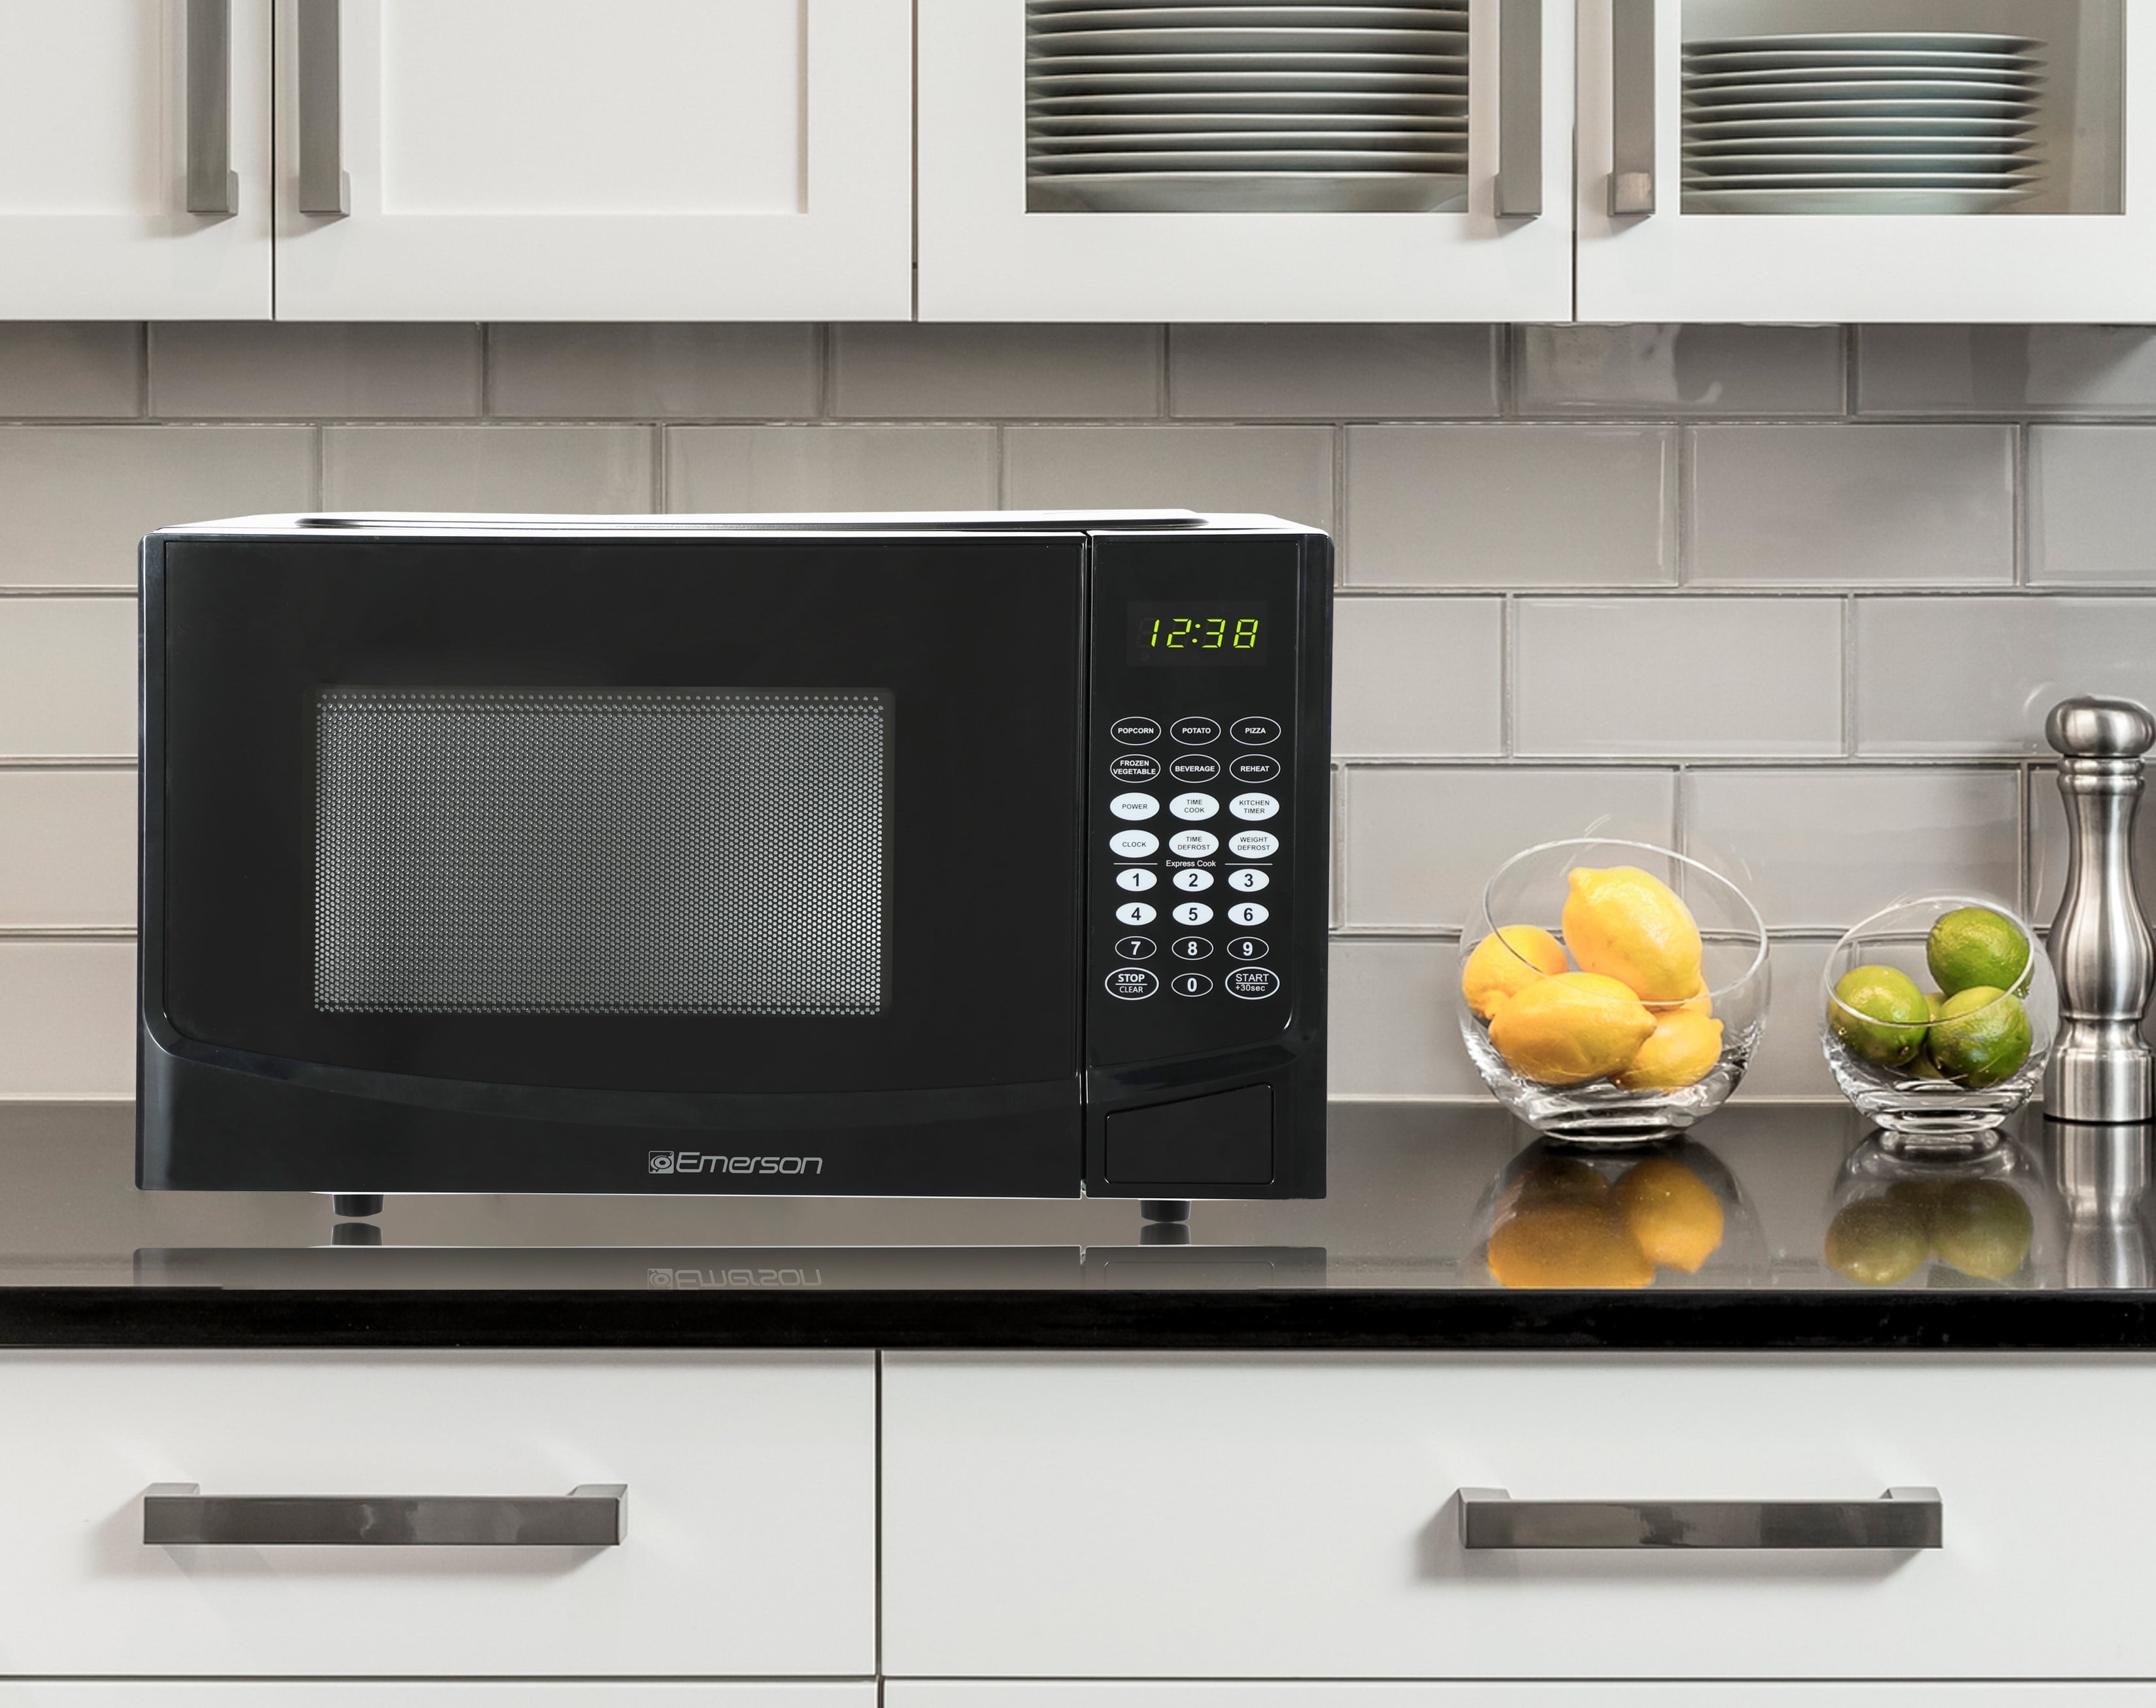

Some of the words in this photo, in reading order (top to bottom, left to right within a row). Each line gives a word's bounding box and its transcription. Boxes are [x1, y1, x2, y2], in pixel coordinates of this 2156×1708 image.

[1151, 618, 1258, 648] 12:38
[1166, 860, 1196, 869] Express
[1132, 873, 1139, 887] 1
[1188, 873, 1198, 887] 2
[1244, 873, 1254, 888] 3
[1131, 907, 1141, 921] 4
[1188, 907, 1198, 922] 5
[1243, 907, 1254, 922] 6
[1130, 941, 1141, 956] 7
[1187, 941, 1198, 956] 8
[1242, 941, 1253, 956] 9
[1118, 973, 1145, 982] STOP
[1187, 977, 1198, 992] 0
[1235, 973, 1270, 982] START
[675, 1151, 823, 1175] Emerson
